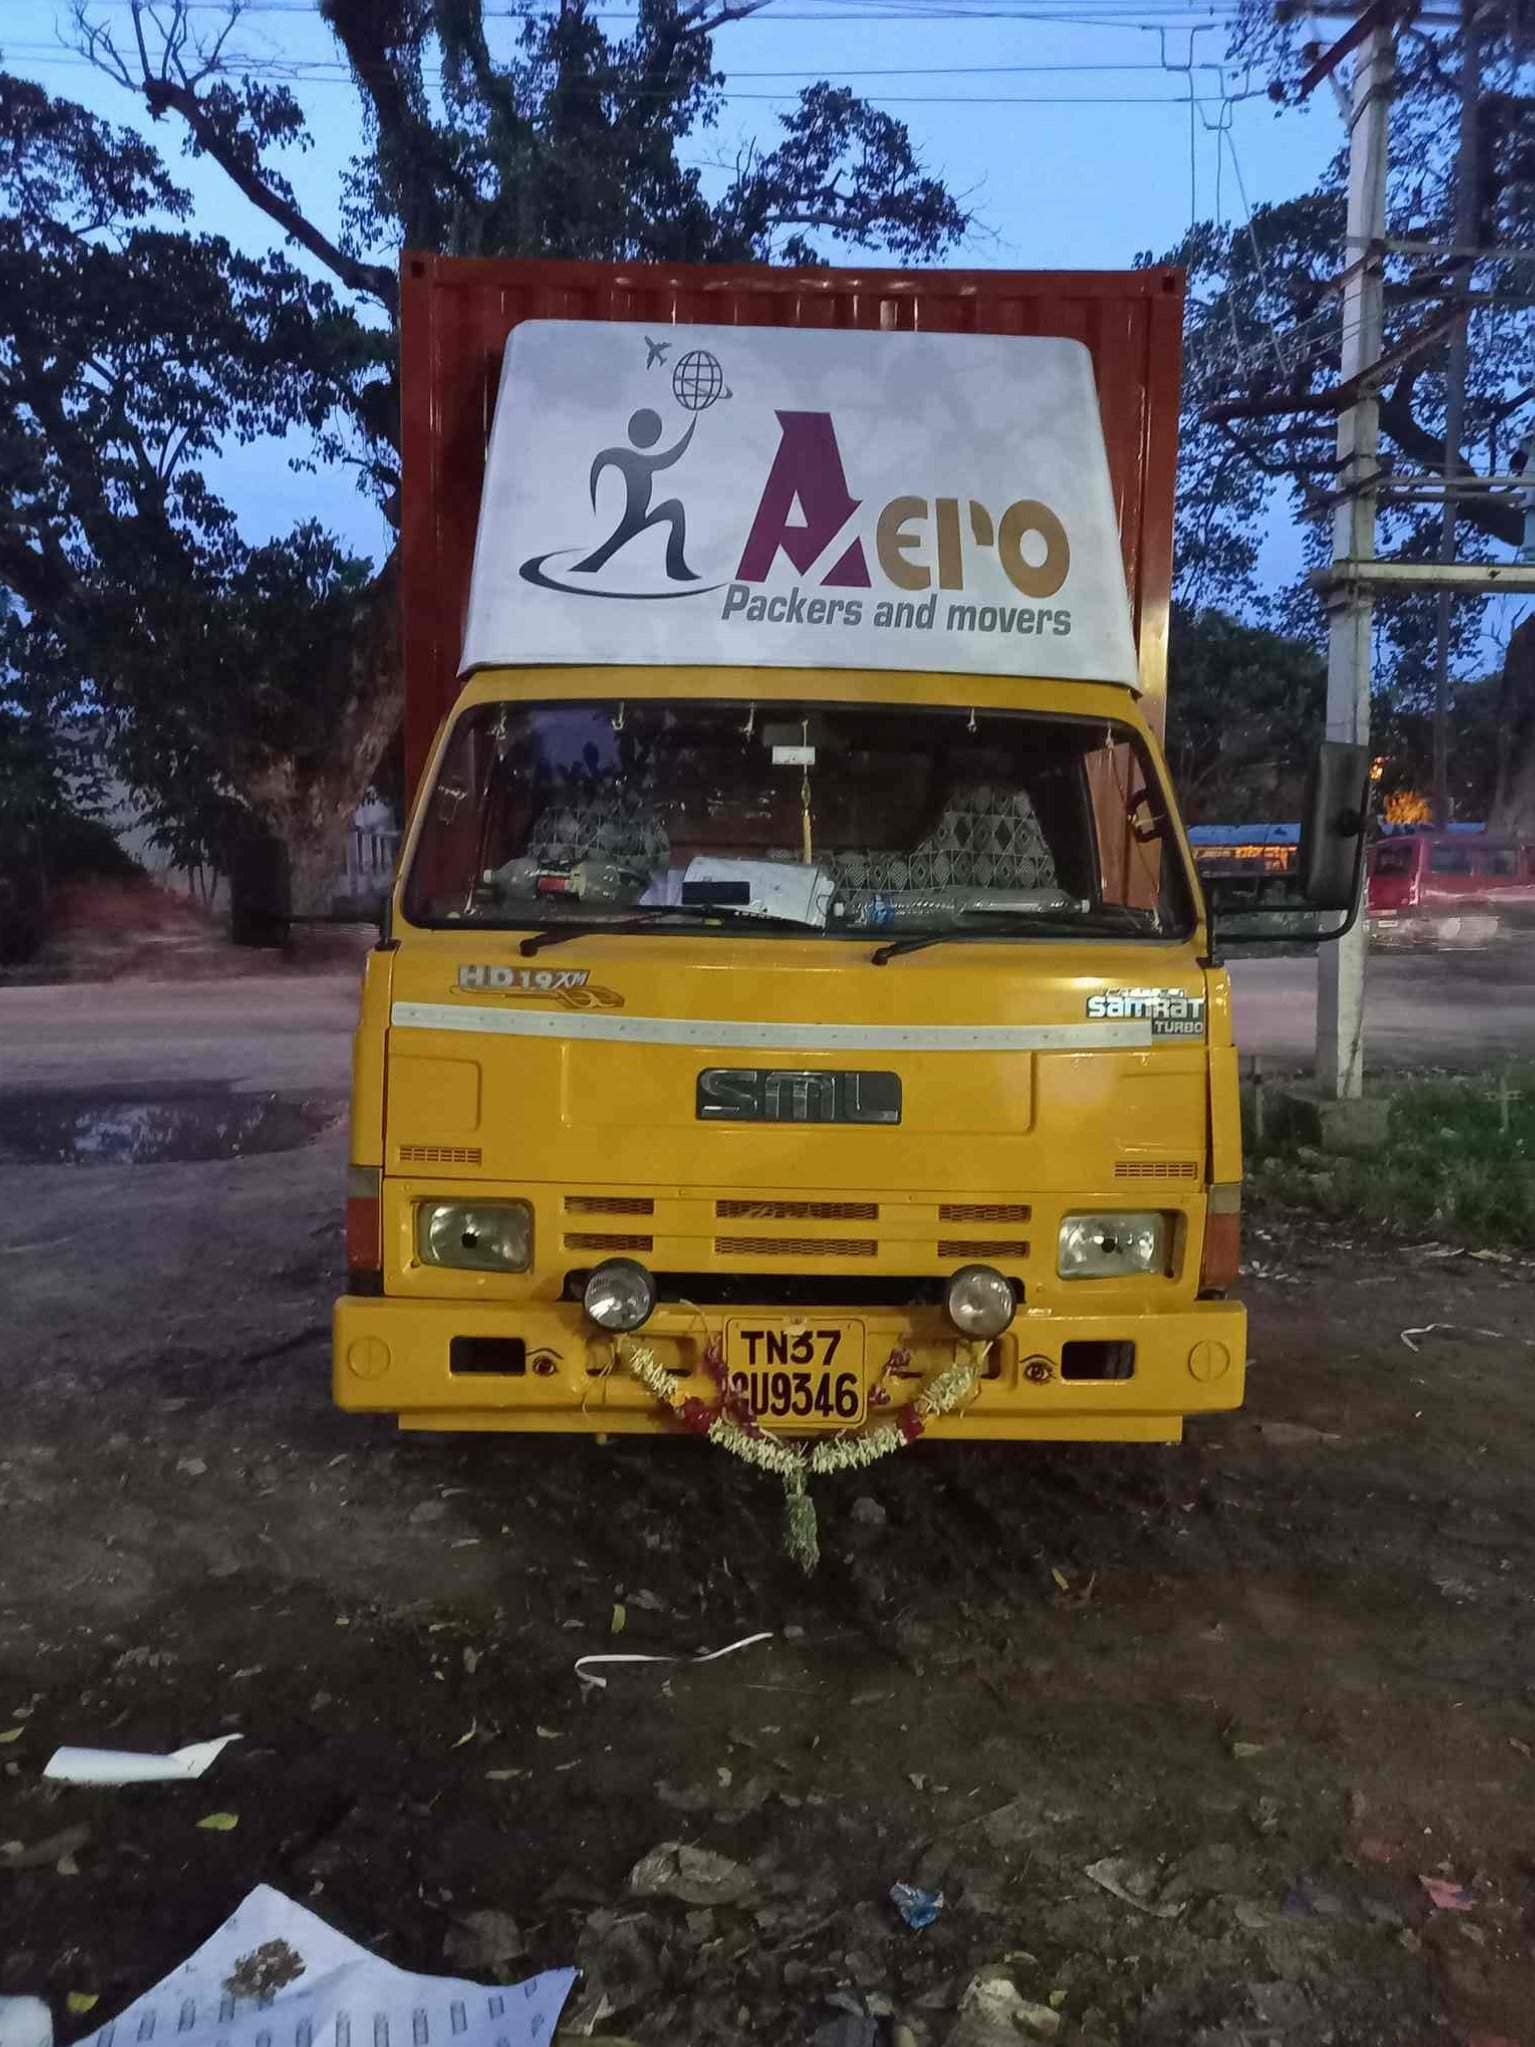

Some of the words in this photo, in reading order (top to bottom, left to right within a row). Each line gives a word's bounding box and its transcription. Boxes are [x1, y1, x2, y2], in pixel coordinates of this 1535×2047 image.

[721, 585, 862, 626] Packers
[874, 594, 937, 629] and
[946, 602, 1071, 636] movers
[1154, 1021, 1204, 1033] TURBO
[740, 1330, 842, 1366] TN37
